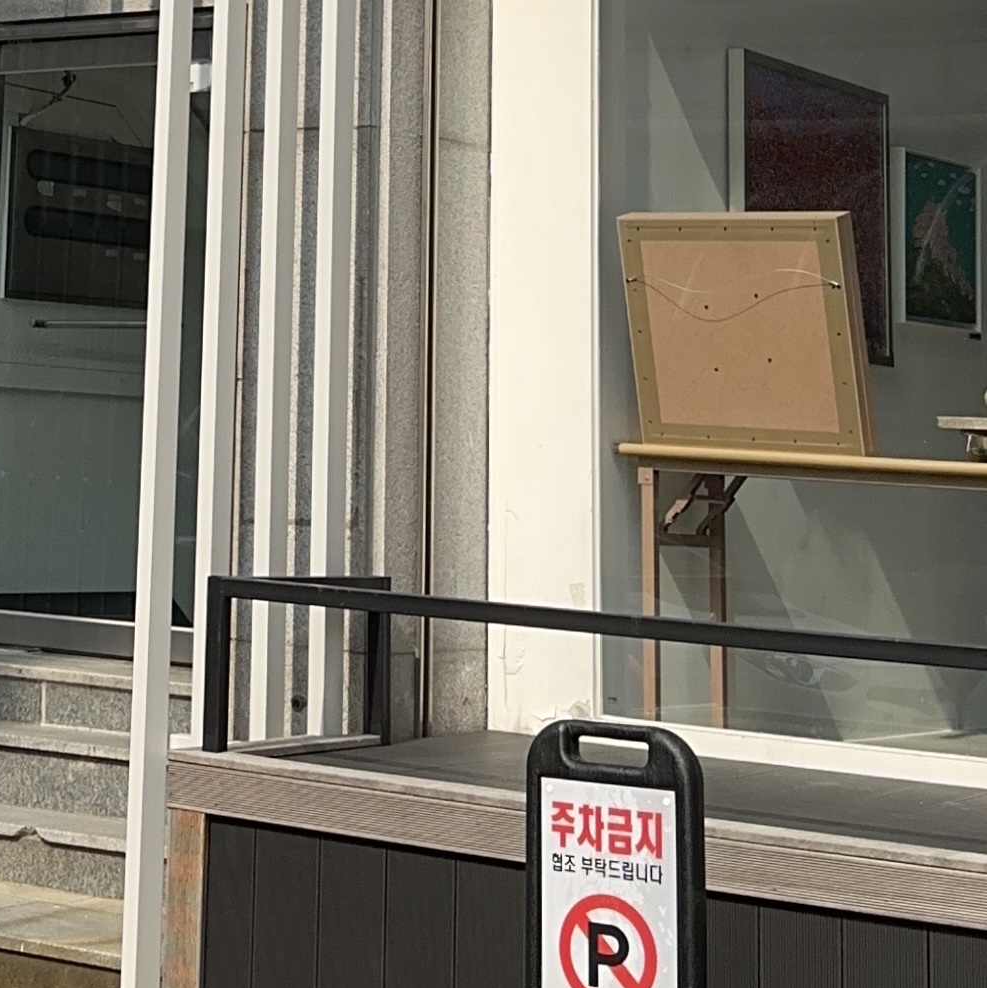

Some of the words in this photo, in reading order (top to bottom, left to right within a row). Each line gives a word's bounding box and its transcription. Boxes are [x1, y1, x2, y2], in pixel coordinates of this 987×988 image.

[551, 801, 663, 860] 주차금지
[552, 852, 576, 873] 협조
[581, 856, 663, 885] 부탁드립니다
[587, 921, 630, 988] P
